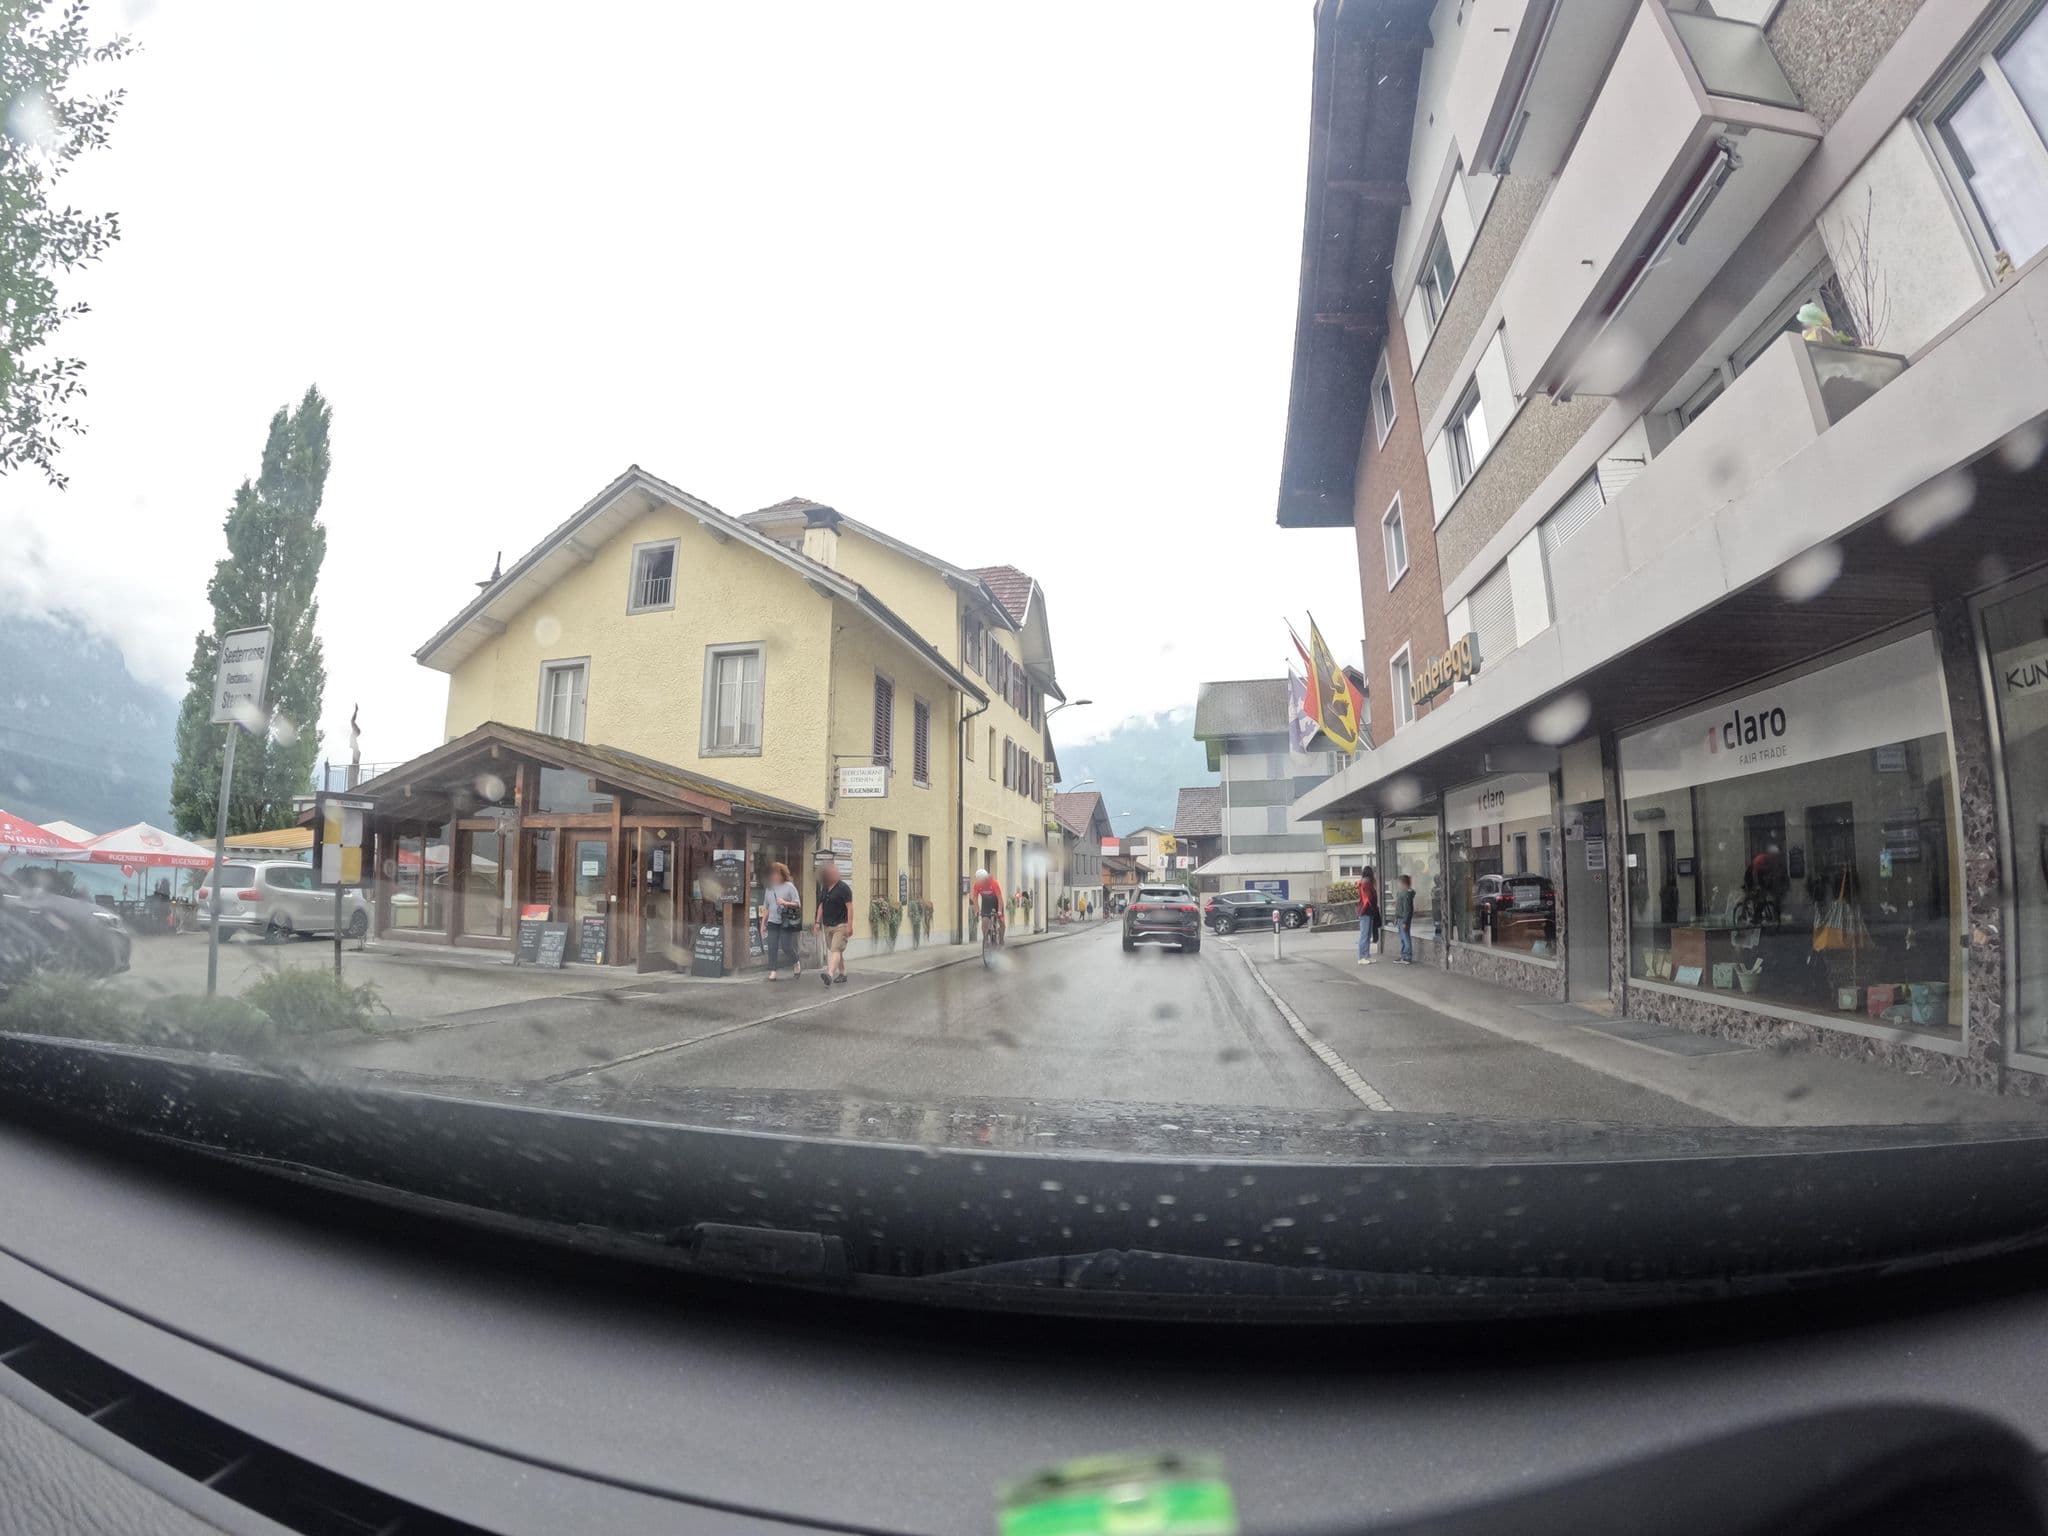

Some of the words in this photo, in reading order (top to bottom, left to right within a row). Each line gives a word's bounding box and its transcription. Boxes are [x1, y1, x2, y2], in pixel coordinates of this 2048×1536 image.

[1723, 708, 1786, 750] claro
[1740, 753, 1757, 765] FAIR
[1759, 745, 1787, 761] TRADE
[1044, 763, 1052, 823] HOTEL
[1483, 788, 1504, 810] claro
